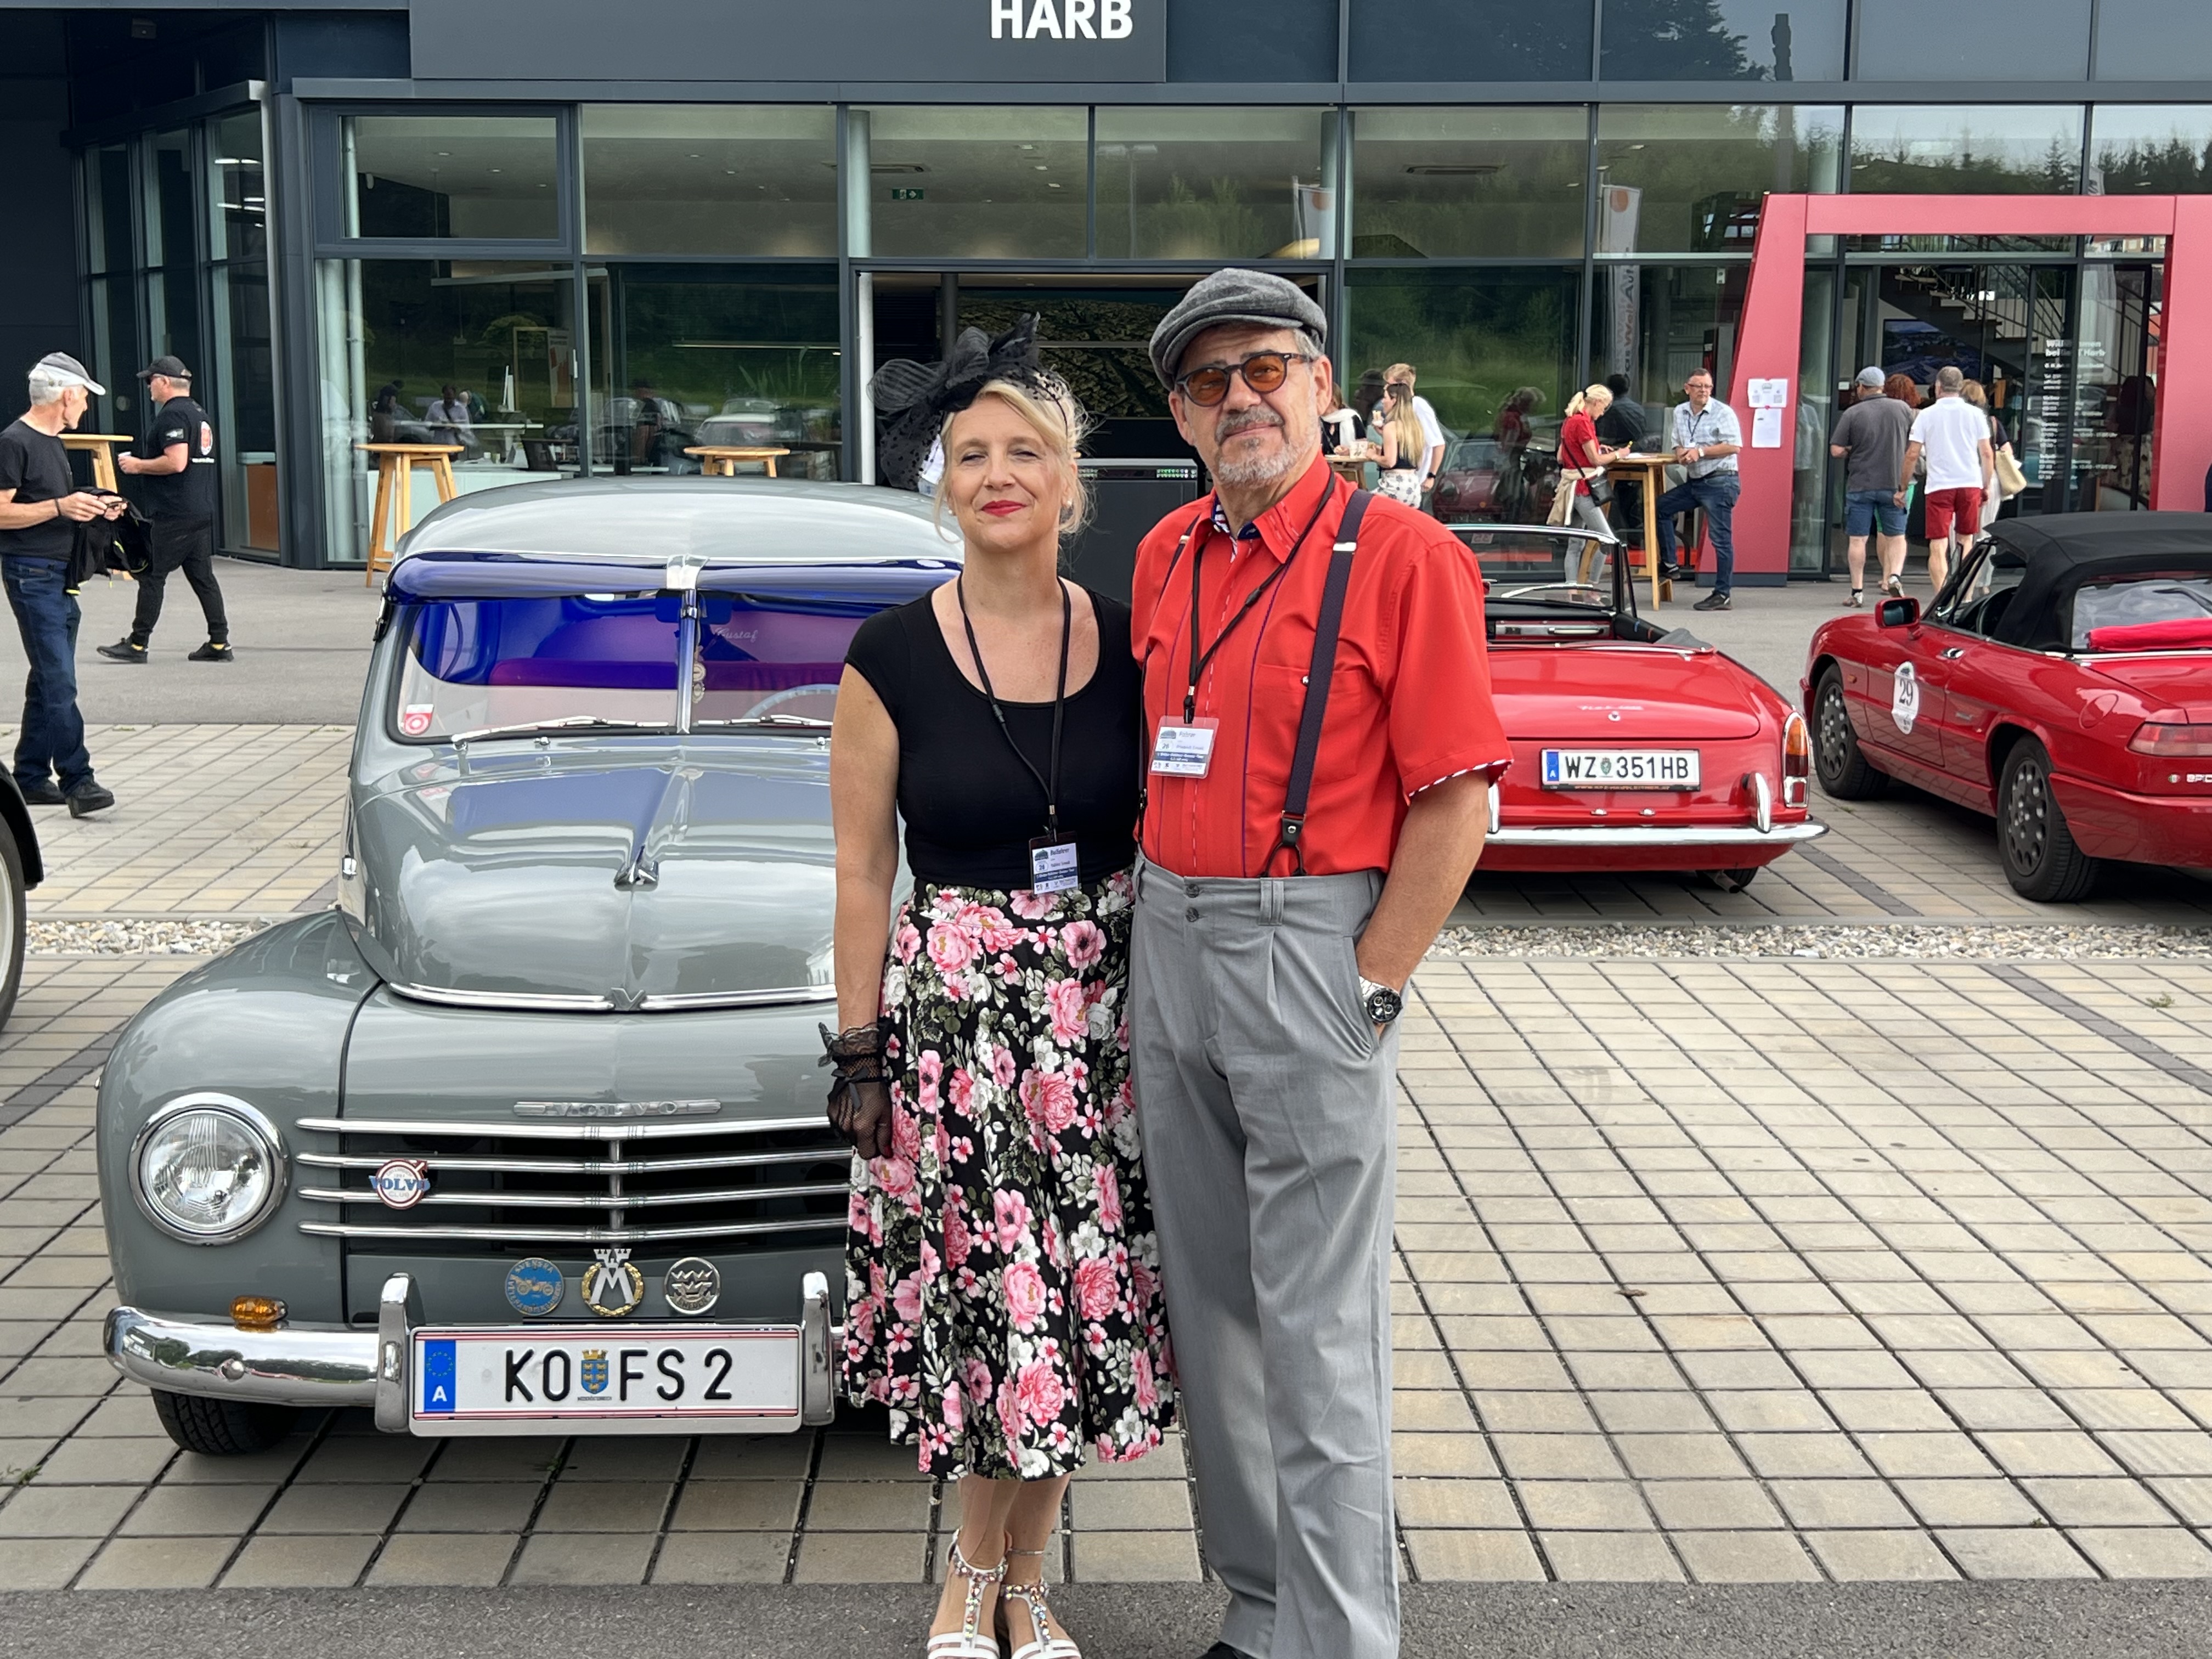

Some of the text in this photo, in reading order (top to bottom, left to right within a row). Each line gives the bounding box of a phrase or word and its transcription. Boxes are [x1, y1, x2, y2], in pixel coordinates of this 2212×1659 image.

[991, 0, 1133, 39] HARB
[1899, 678, 1914, 707] 29
[1549, 770, 1556, 778] A
[1565, 756, 1689, 779] WZ 351HB
[368, 1175, 431, 1192] VOLVO
[505, 1347, 733, 1402] KO FS 2
[432, 1386, 448, 1402] A
